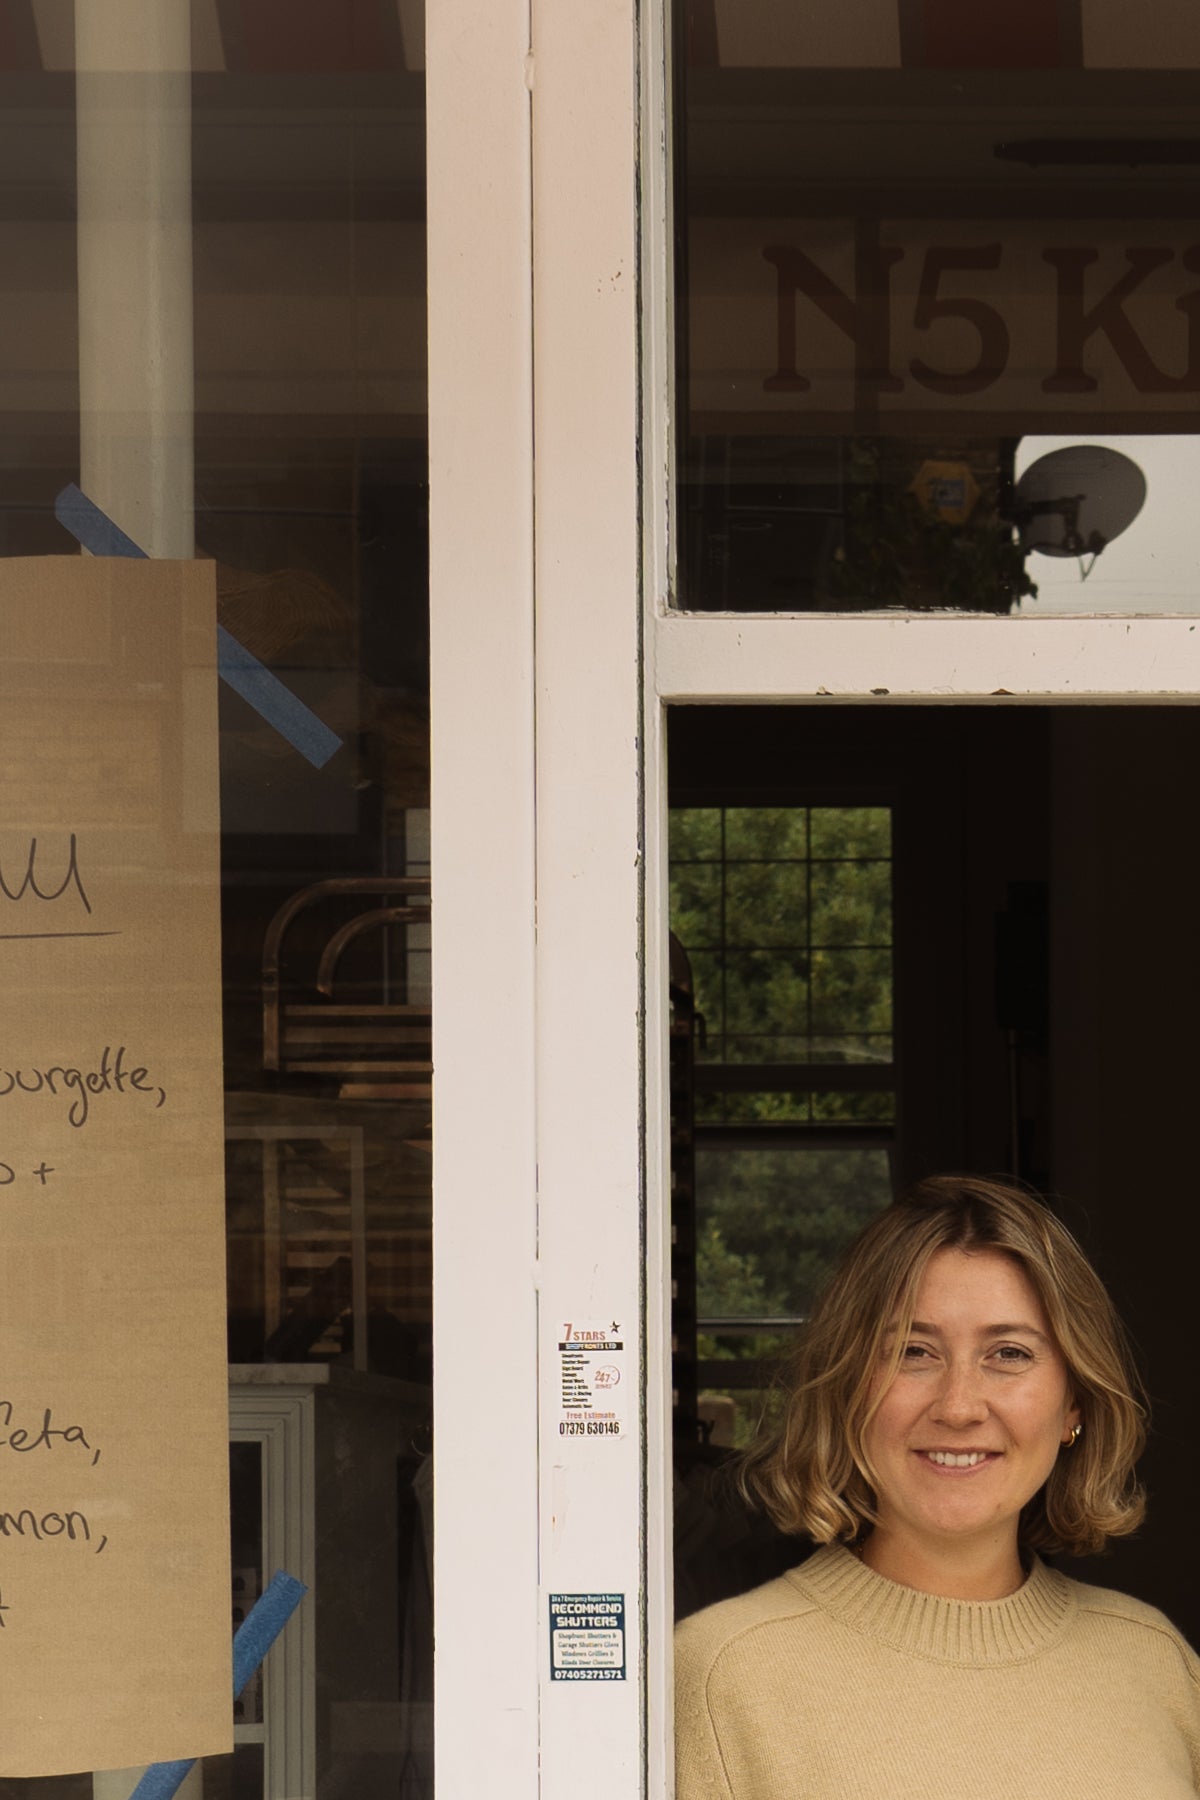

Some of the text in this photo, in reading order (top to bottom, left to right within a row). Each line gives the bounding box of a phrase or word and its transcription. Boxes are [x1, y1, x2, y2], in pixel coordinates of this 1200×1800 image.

[761, 241, 1010, 395] N5
[563, 1323, 606, 1341] 7 STARS
[559, 1422, 620, 1435] 07379 630146
[551, 1603, 622, 1615] RECOMMEND
[556, 1616, 618, 1627] SHUTTERS
[554, 1670, 623, 1680] 07405271571
